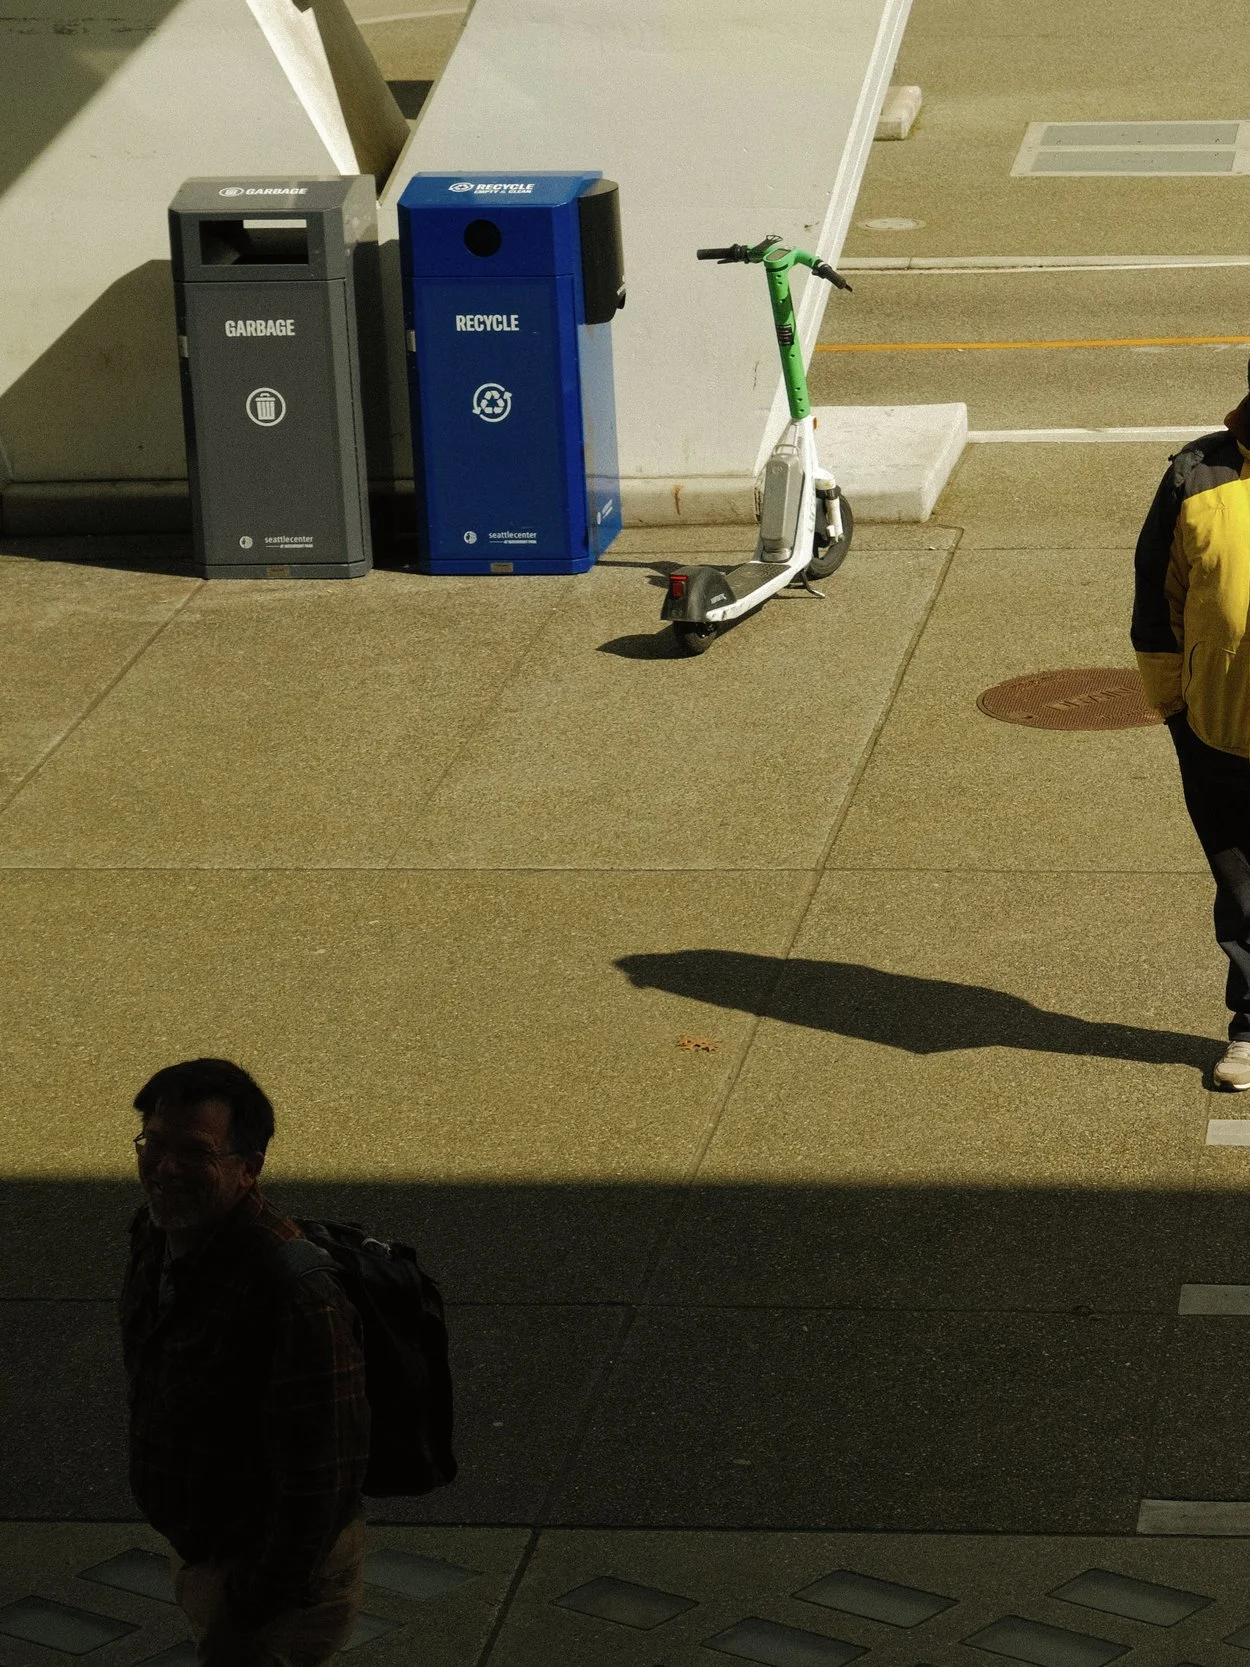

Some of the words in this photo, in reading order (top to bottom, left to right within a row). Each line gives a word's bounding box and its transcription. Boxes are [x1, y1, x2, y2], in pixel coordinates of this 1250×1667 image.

[245, 187, 308, 195] GARBAGE
[455, 314, 520, 332] RECYCLE
[225, 319, 296, 337] GARBAGE
[264, 535, 314, 543] seattlecenter
[488, 531, 537, 539] seattlecenter
